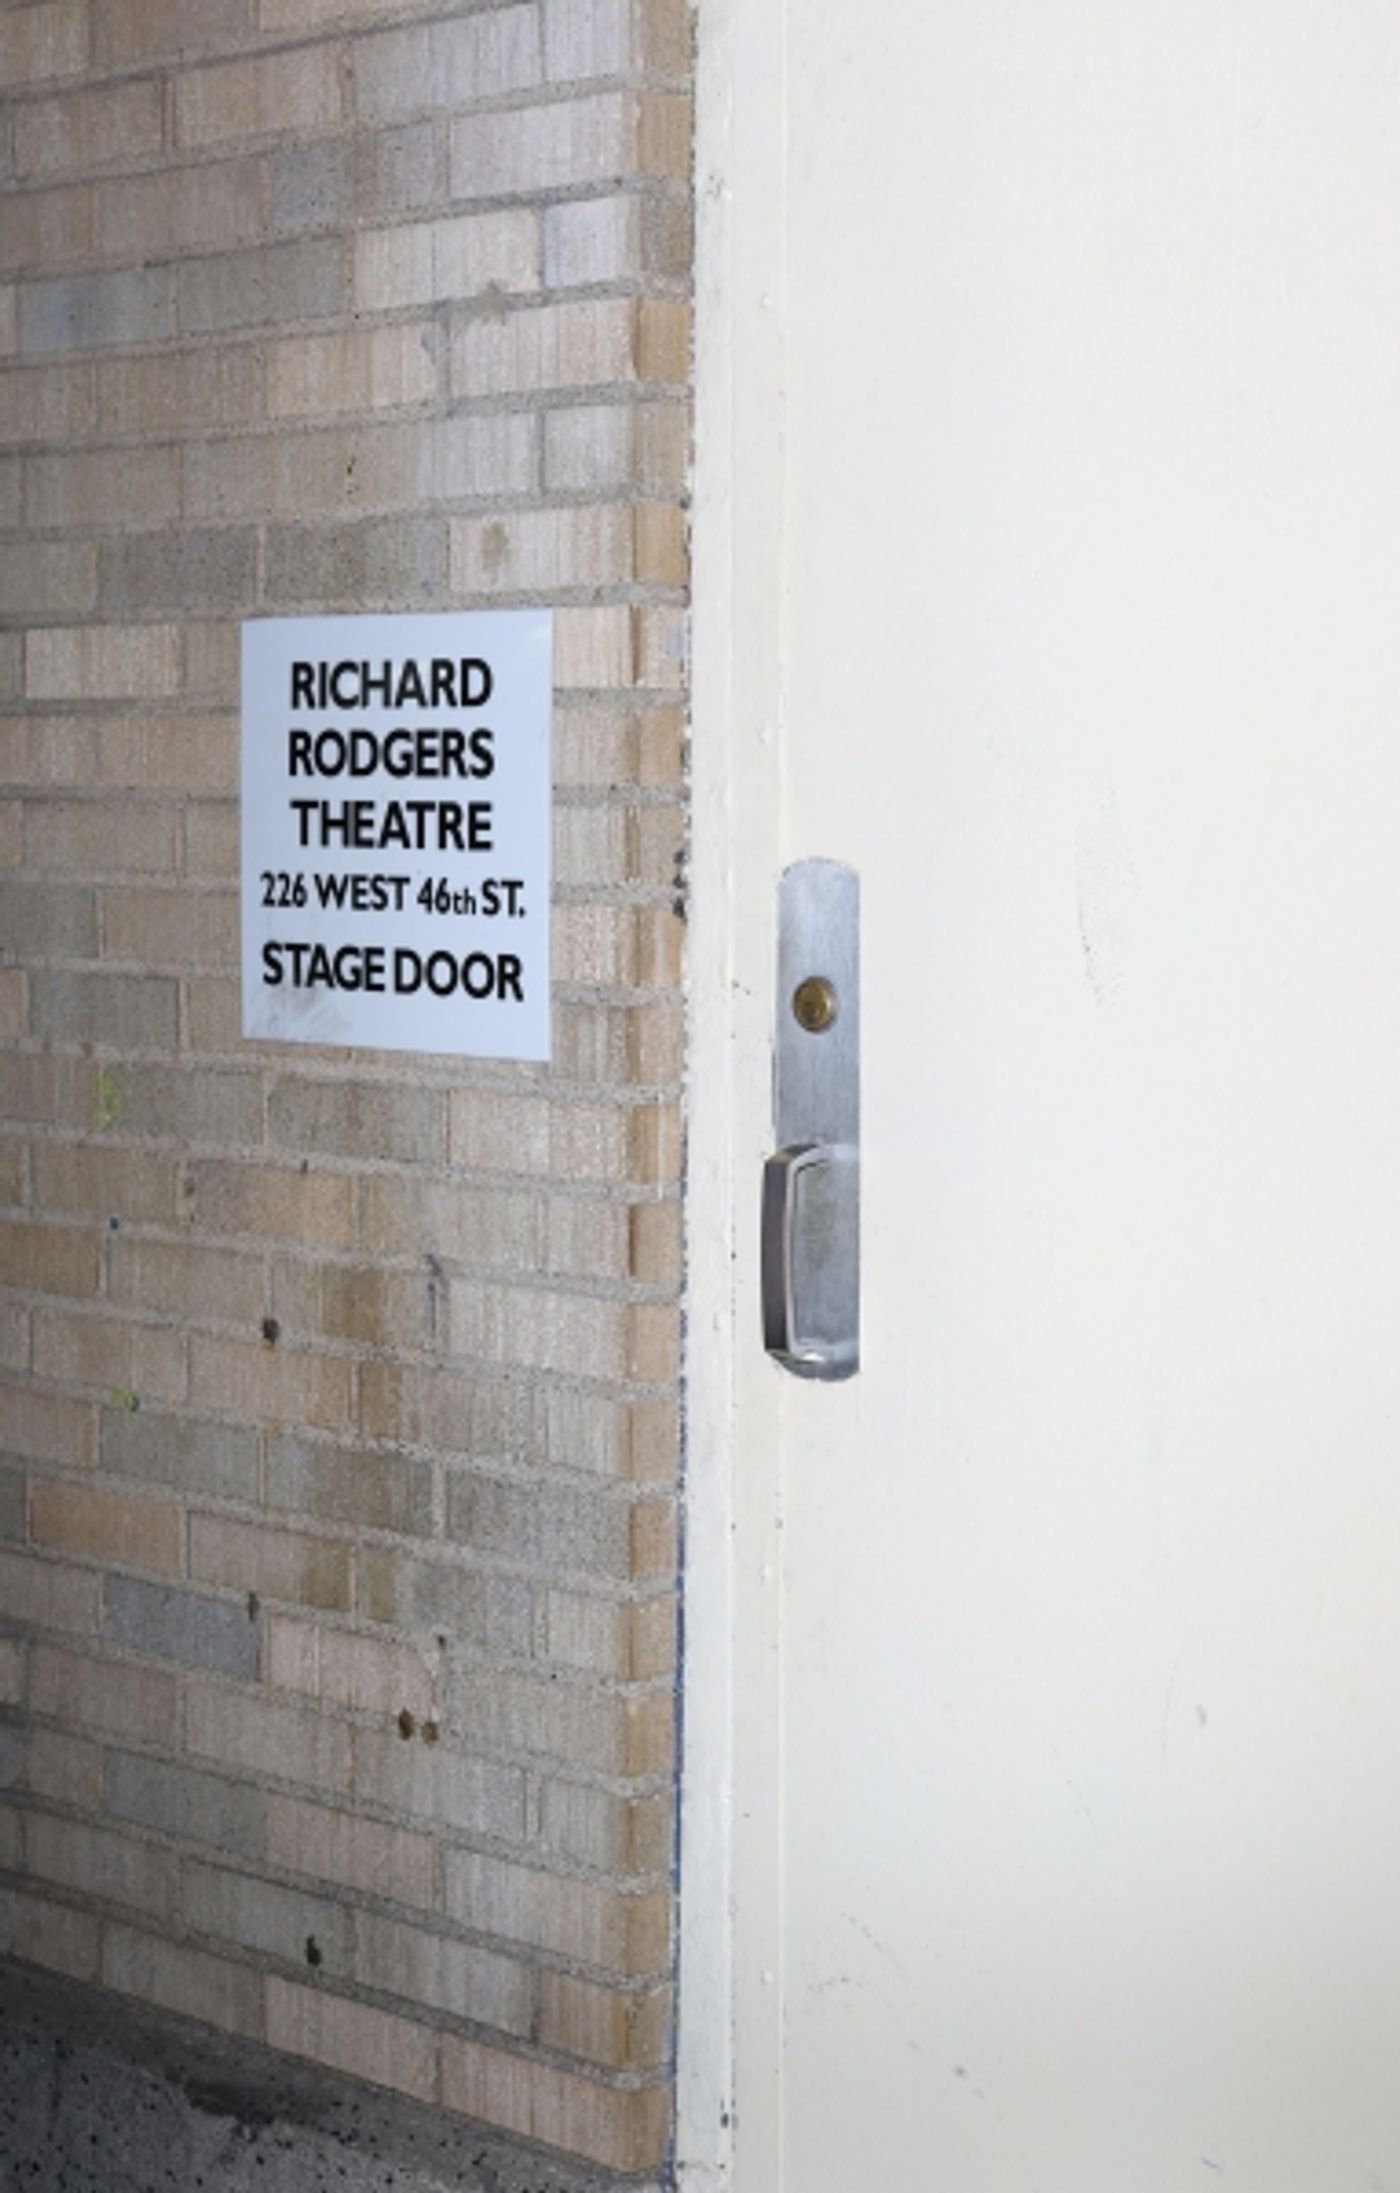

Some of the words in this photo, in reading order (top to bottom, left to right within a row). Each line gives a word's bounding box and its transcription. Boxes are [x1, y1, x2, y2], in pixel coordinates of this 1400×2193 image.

[290, 657, 494, 711] RICHARD
[288, 727, 495, 780] RODGERS
[289, 799, 494, 852] THEATRE
[260, 870, 309, 909] 226
[312, 872, 412, 912] WEST
[416, 876, 477, 916] 46th
[480, 877, 527, 919] ST.
[261, 938, 387, 993] STAGE
[393, 946, 525, 1003] DOOR
